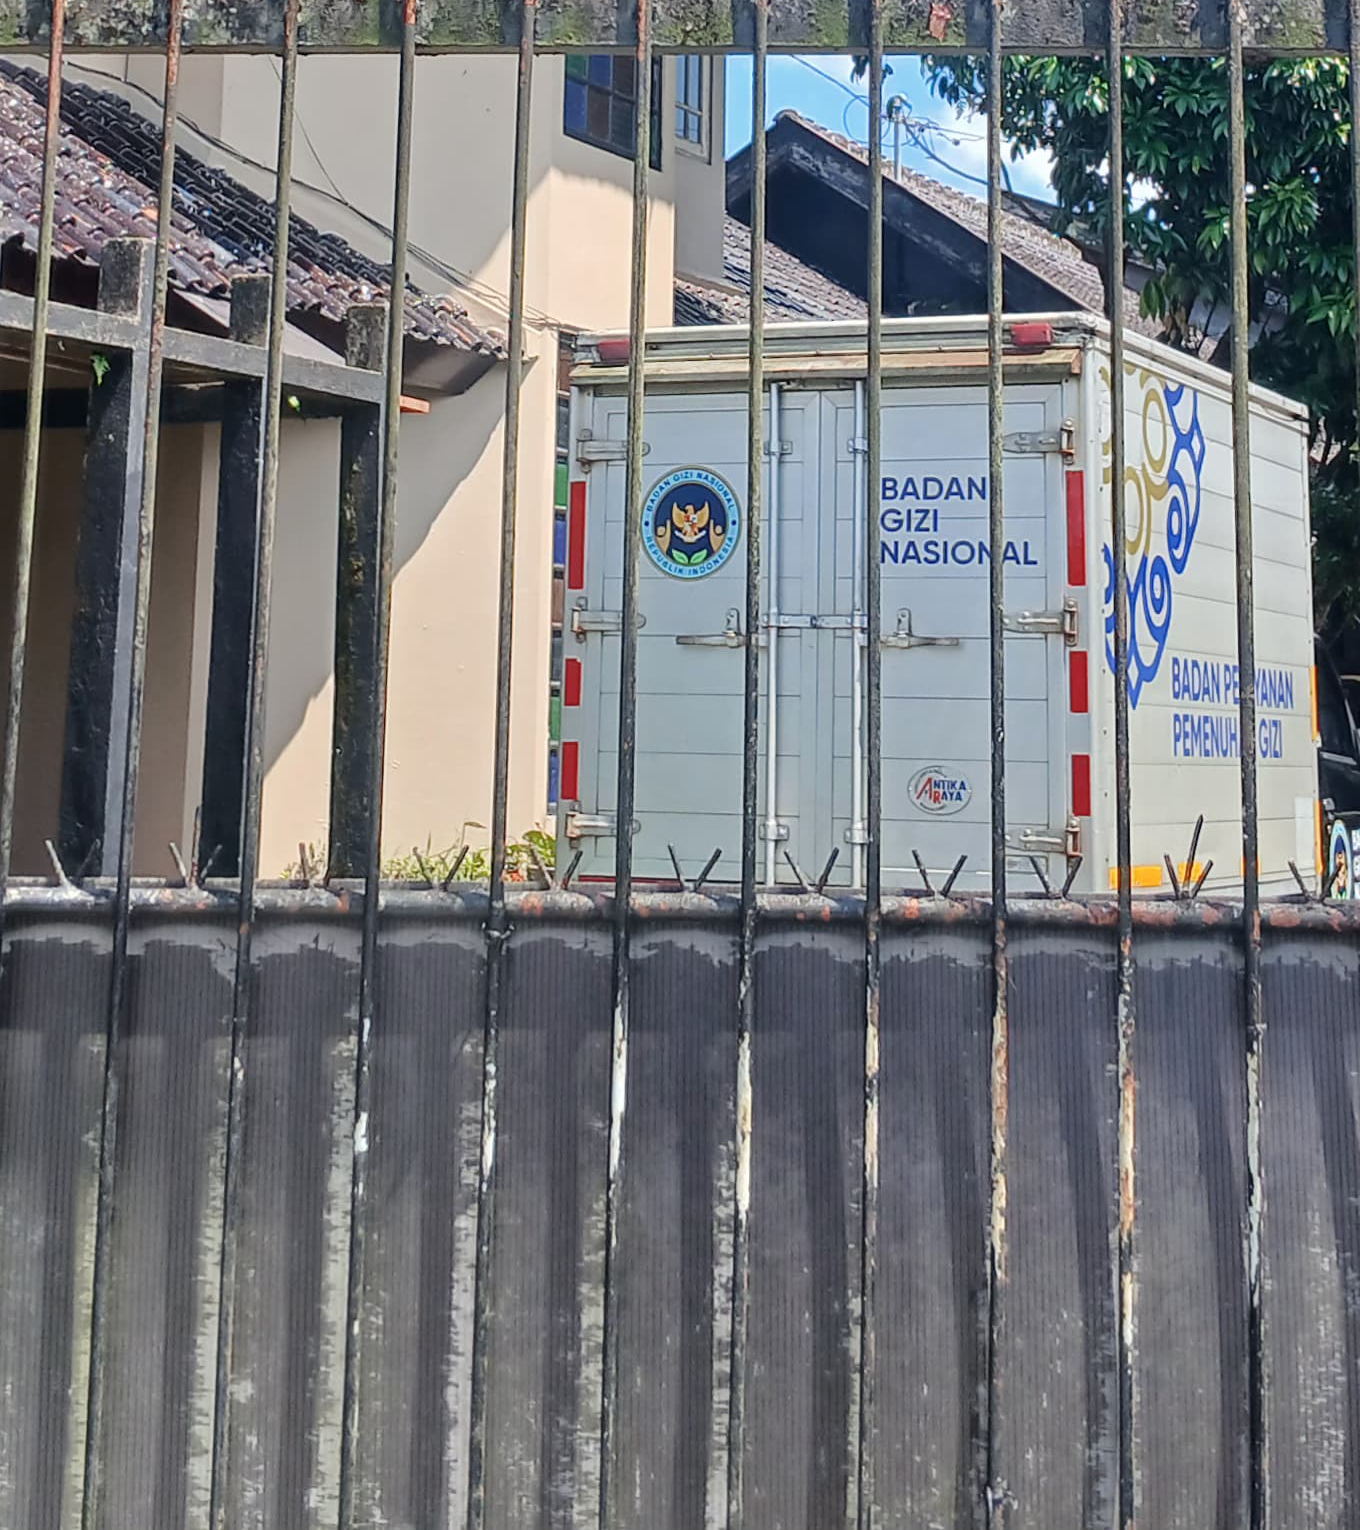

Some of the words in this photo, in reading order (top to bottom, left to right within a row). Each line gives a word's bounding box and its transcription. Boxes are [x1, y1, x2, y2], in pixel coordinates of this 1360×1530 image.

[646, 479, 671, 512] BADAN
[672, 471, 694, 482] GIZI
[696, 471, 736, 510] NASIONAL
[881, 476, 987, 501] BADAN
[880, 508, 938, 533] GIZI
[645, 535, 684, 575] REPUBLIK
[687, 536, 734, 576] INDONESIA
[880, 540, 1038, 566] NASIONAL
[1171, 656, 1221, 704] BADAN
[1223, 662, 1295, 710] PEYANAN
[1173, 713, 1242, 758] PEMENUH
[1258, 717, 1284, 759] GIZI
[916, 777, 967, 801] ANTIKA
[933, 790, 963, 804] RAYA
